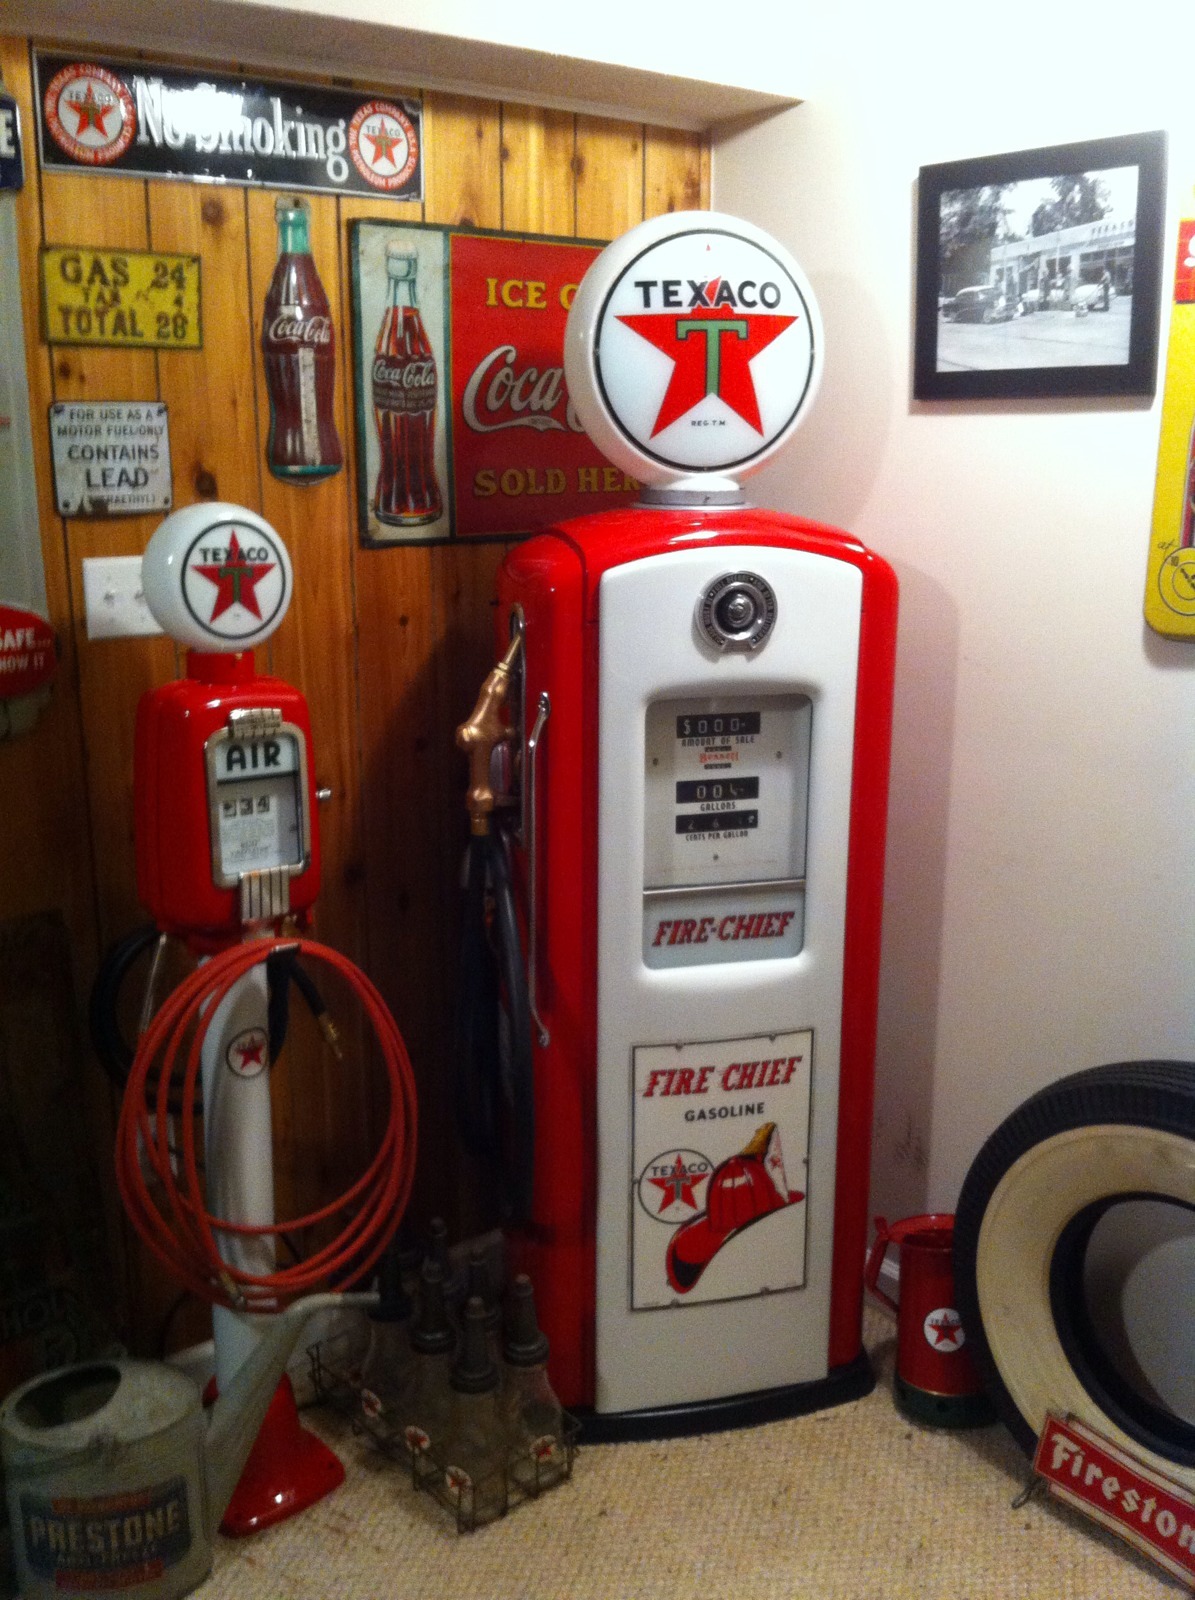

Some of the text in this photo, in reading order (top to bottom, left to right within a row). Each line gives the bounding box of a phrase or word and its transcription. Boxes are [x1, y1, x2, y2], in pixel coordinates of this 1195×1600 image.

[194, 82, 349, 183] Smoking
[366, 124, 401, 137] TEXACO
[60, 252, 186, 291] GAS 24
[485, 277, 547, 310] ICE
[633, 279, 782, 310] TEXACO
[57, 303, 189, 340] TOTAL 28
[69, 408, 154, 421] FOR USE AS A
[57, 424, 165, 437] MOTOR FUEL ONLY
[67, 444, 160, 461] CONTAINS
[85, 466, 150, 489] LEAD
[473, 467, 568, 497] SOLD
[200, 546, 270, 563] TEXACO
[682, 734, 756, 748] AMOUNT OF SALE
[226, 744, 281, 772] AIR
[700, 801, 737, 812] GALLONS
[685, 829, 749, 842] CENTS PER GALLON
[642, 1055, 803, 1098] FIRE CHIEF
[684, 1102, 766, 1123] GASOLINE
[651, 1161, 709, 1177] TEXACO
